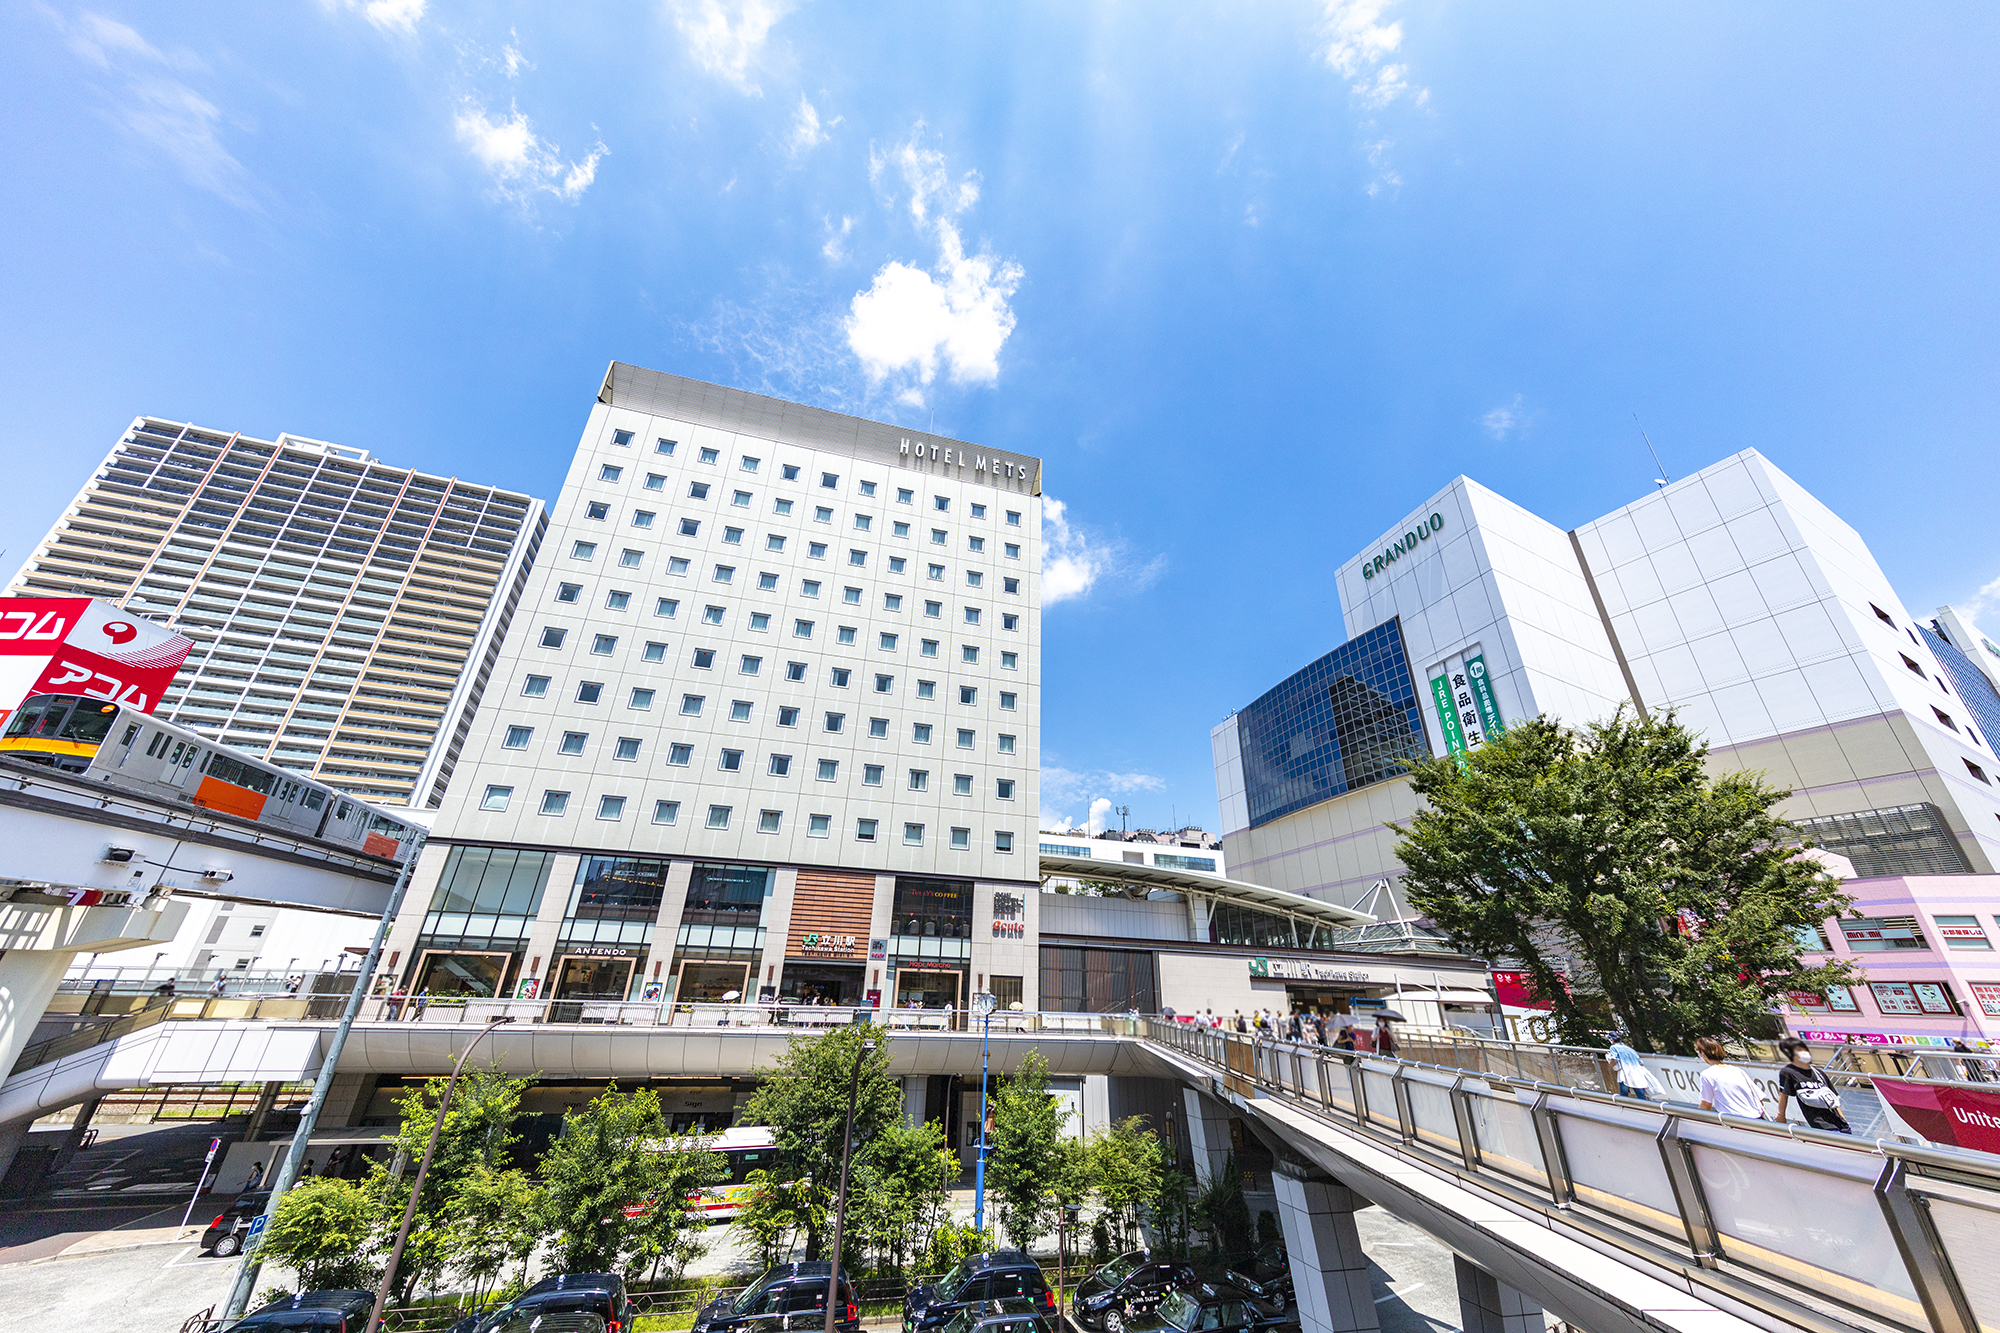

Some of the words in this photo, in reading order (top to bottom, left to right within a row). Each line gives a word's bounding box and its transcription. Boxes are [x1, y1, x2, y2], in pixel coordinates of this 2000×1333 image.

[900, 438, 965, 467] HOTEL
[975, 455, 1026, 480] METS
[1362, 511, 1444, 581] GRANDUO
[0, 610, 66, 641] コム
[48, 660, 148, 712] アコム
[1437, 680, 1449, 709] JRE
[1452, 673, 1484, 747] 食品衛生
[992, 920, 1025, 931] ecute
[574, 946, 627, 956] ANTENDO
[801, 944, 833, 952] Tachikawa
[833, 945, 855, 953] Station
[802, 933, 819, 943] JR
[820, 934, 856, 947] 立川駅
[1248, 956, 1269, 971] JR
[251, 1217, 265, 1234] P
